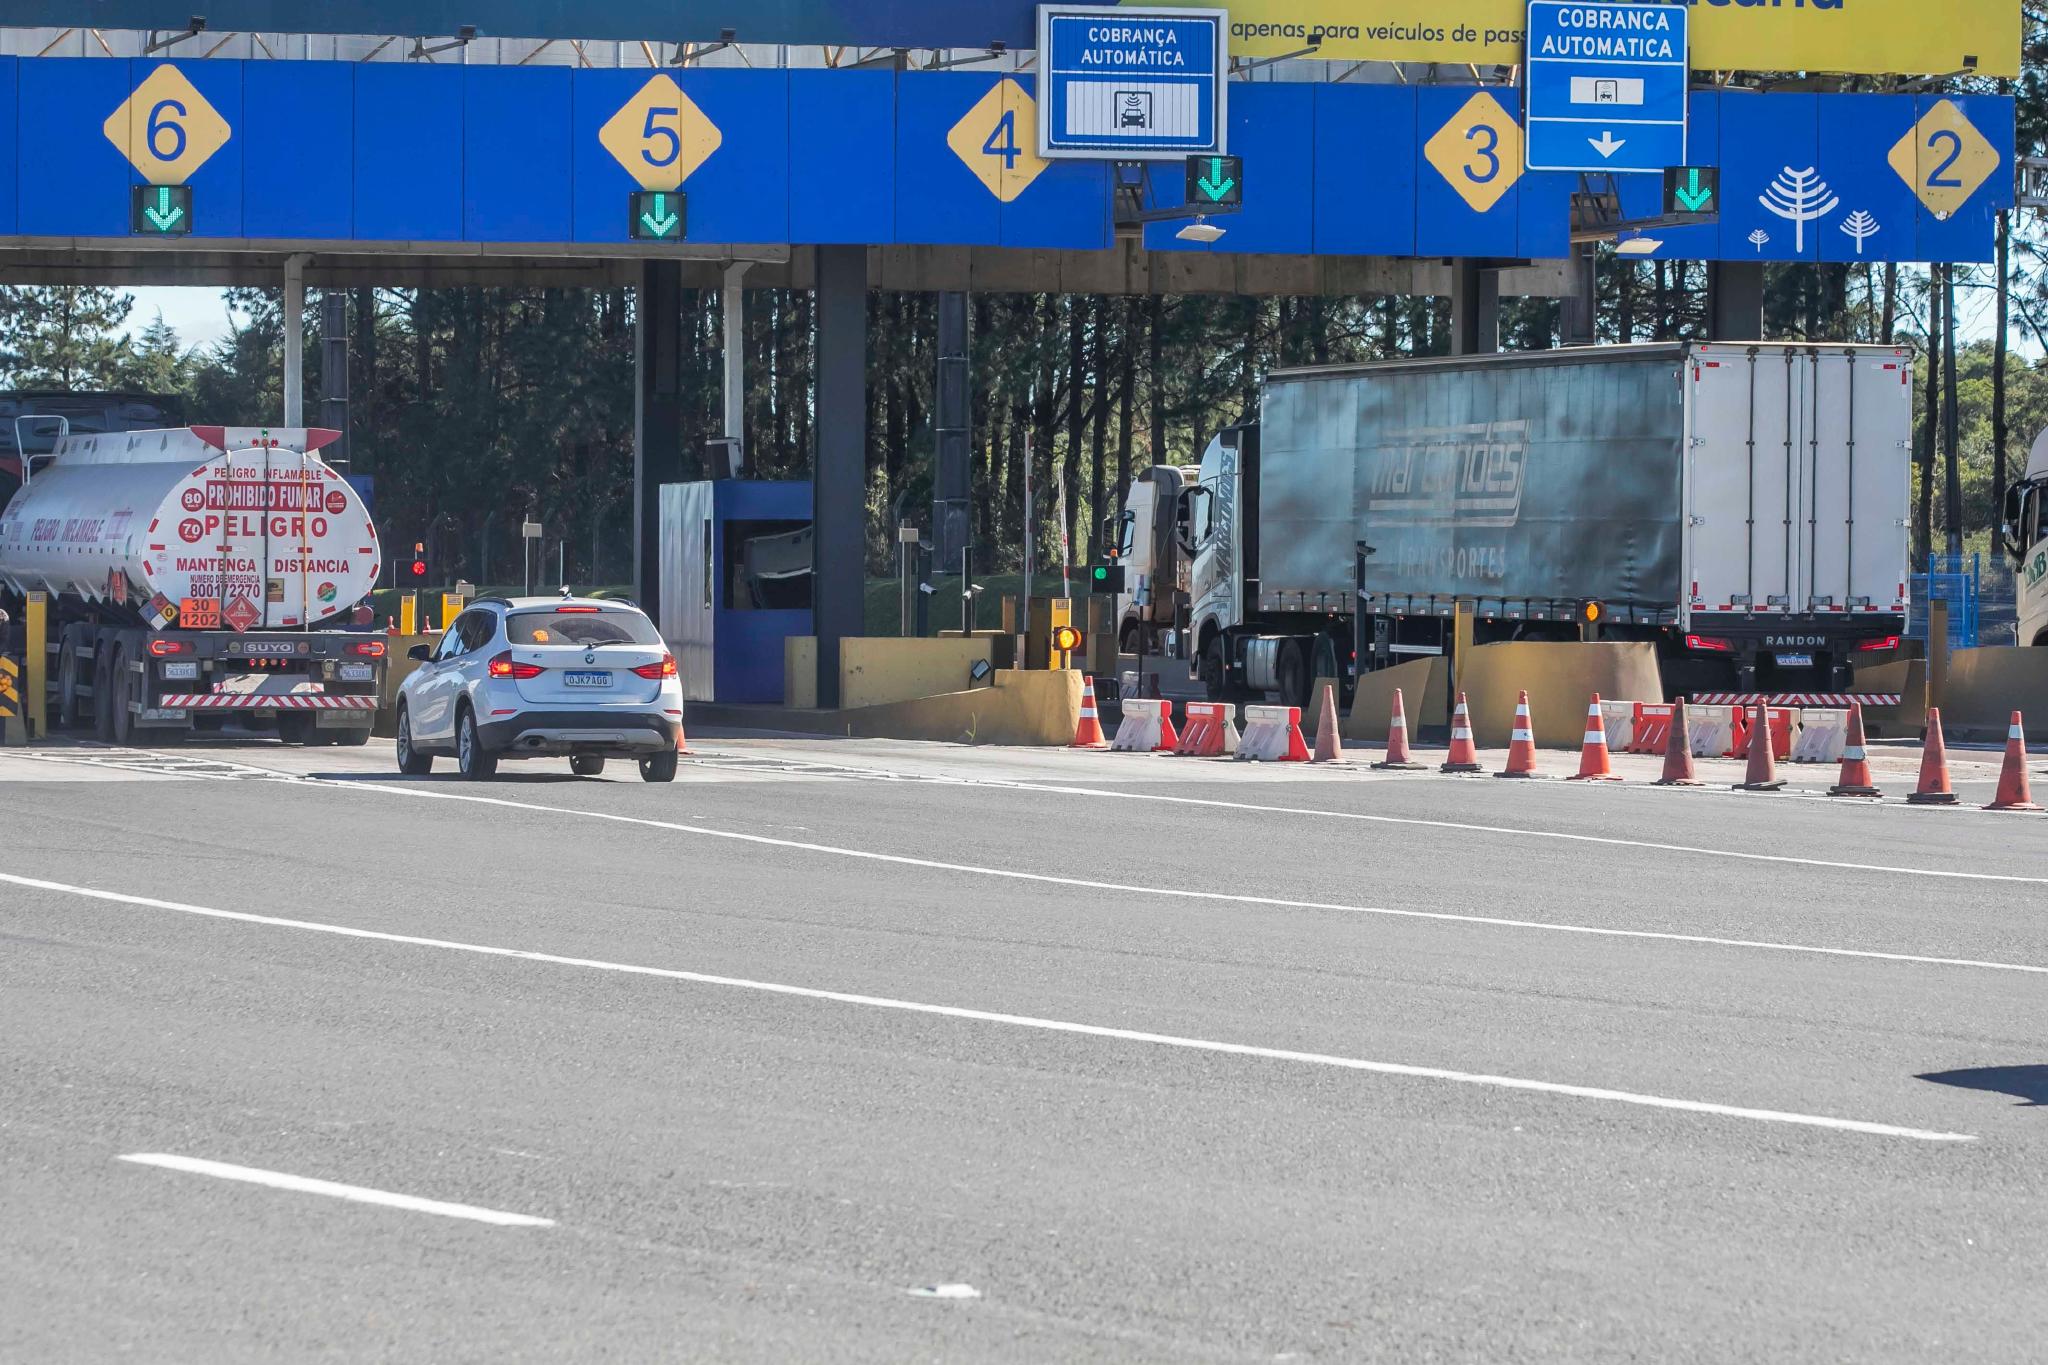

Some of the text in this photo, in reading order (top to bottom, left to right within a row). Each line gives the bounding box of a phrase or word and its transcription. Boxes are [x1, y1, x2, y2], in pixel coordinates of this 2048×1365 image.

[1558, 8, 1670, 31] COBRANCA
[1089, 27, 1177, 46] COBRANÇA
[1231, 23, 1305, 41] apenas
[1313, 25, 1359, 40] para
[1366, 22, 1445, 42] veículos
[1452, 24, 1477, 42] de
[1081, 46, 1184, 66] AUTOMÁTICA
[1541, 35, 1673, 58] AUTOMATICA
[147, 99, 187, 162] 6
[641, 106, 681, 167] 5
[982, 110, 1021, 169] 4
[1463, 124, 1500, 183] 3
[1926, 130, 1962, 188] 2
[214, 467, 322, 480] PELIGRO INFLAMABLE
[185, 493, 202, 504] 80
[208, 484, 321, 508] PROHIBIDO FUMAR
[182, 523, 201, 535] 70
[205, 515, 327, 537] PELIGRO
[176, 558, 256, 572] MANTENGA
[274, 559, 350, 573] DISTANCIA
[190, 584, 260, 598] 800172270
[165, 607, 173, 618] 0
[192, 600, 210, 611] 30
[182, 613, 218, 626] 1202
[247, 644, 292, 652] SUYO
[1766, 636, 1825, 645] RANDON
